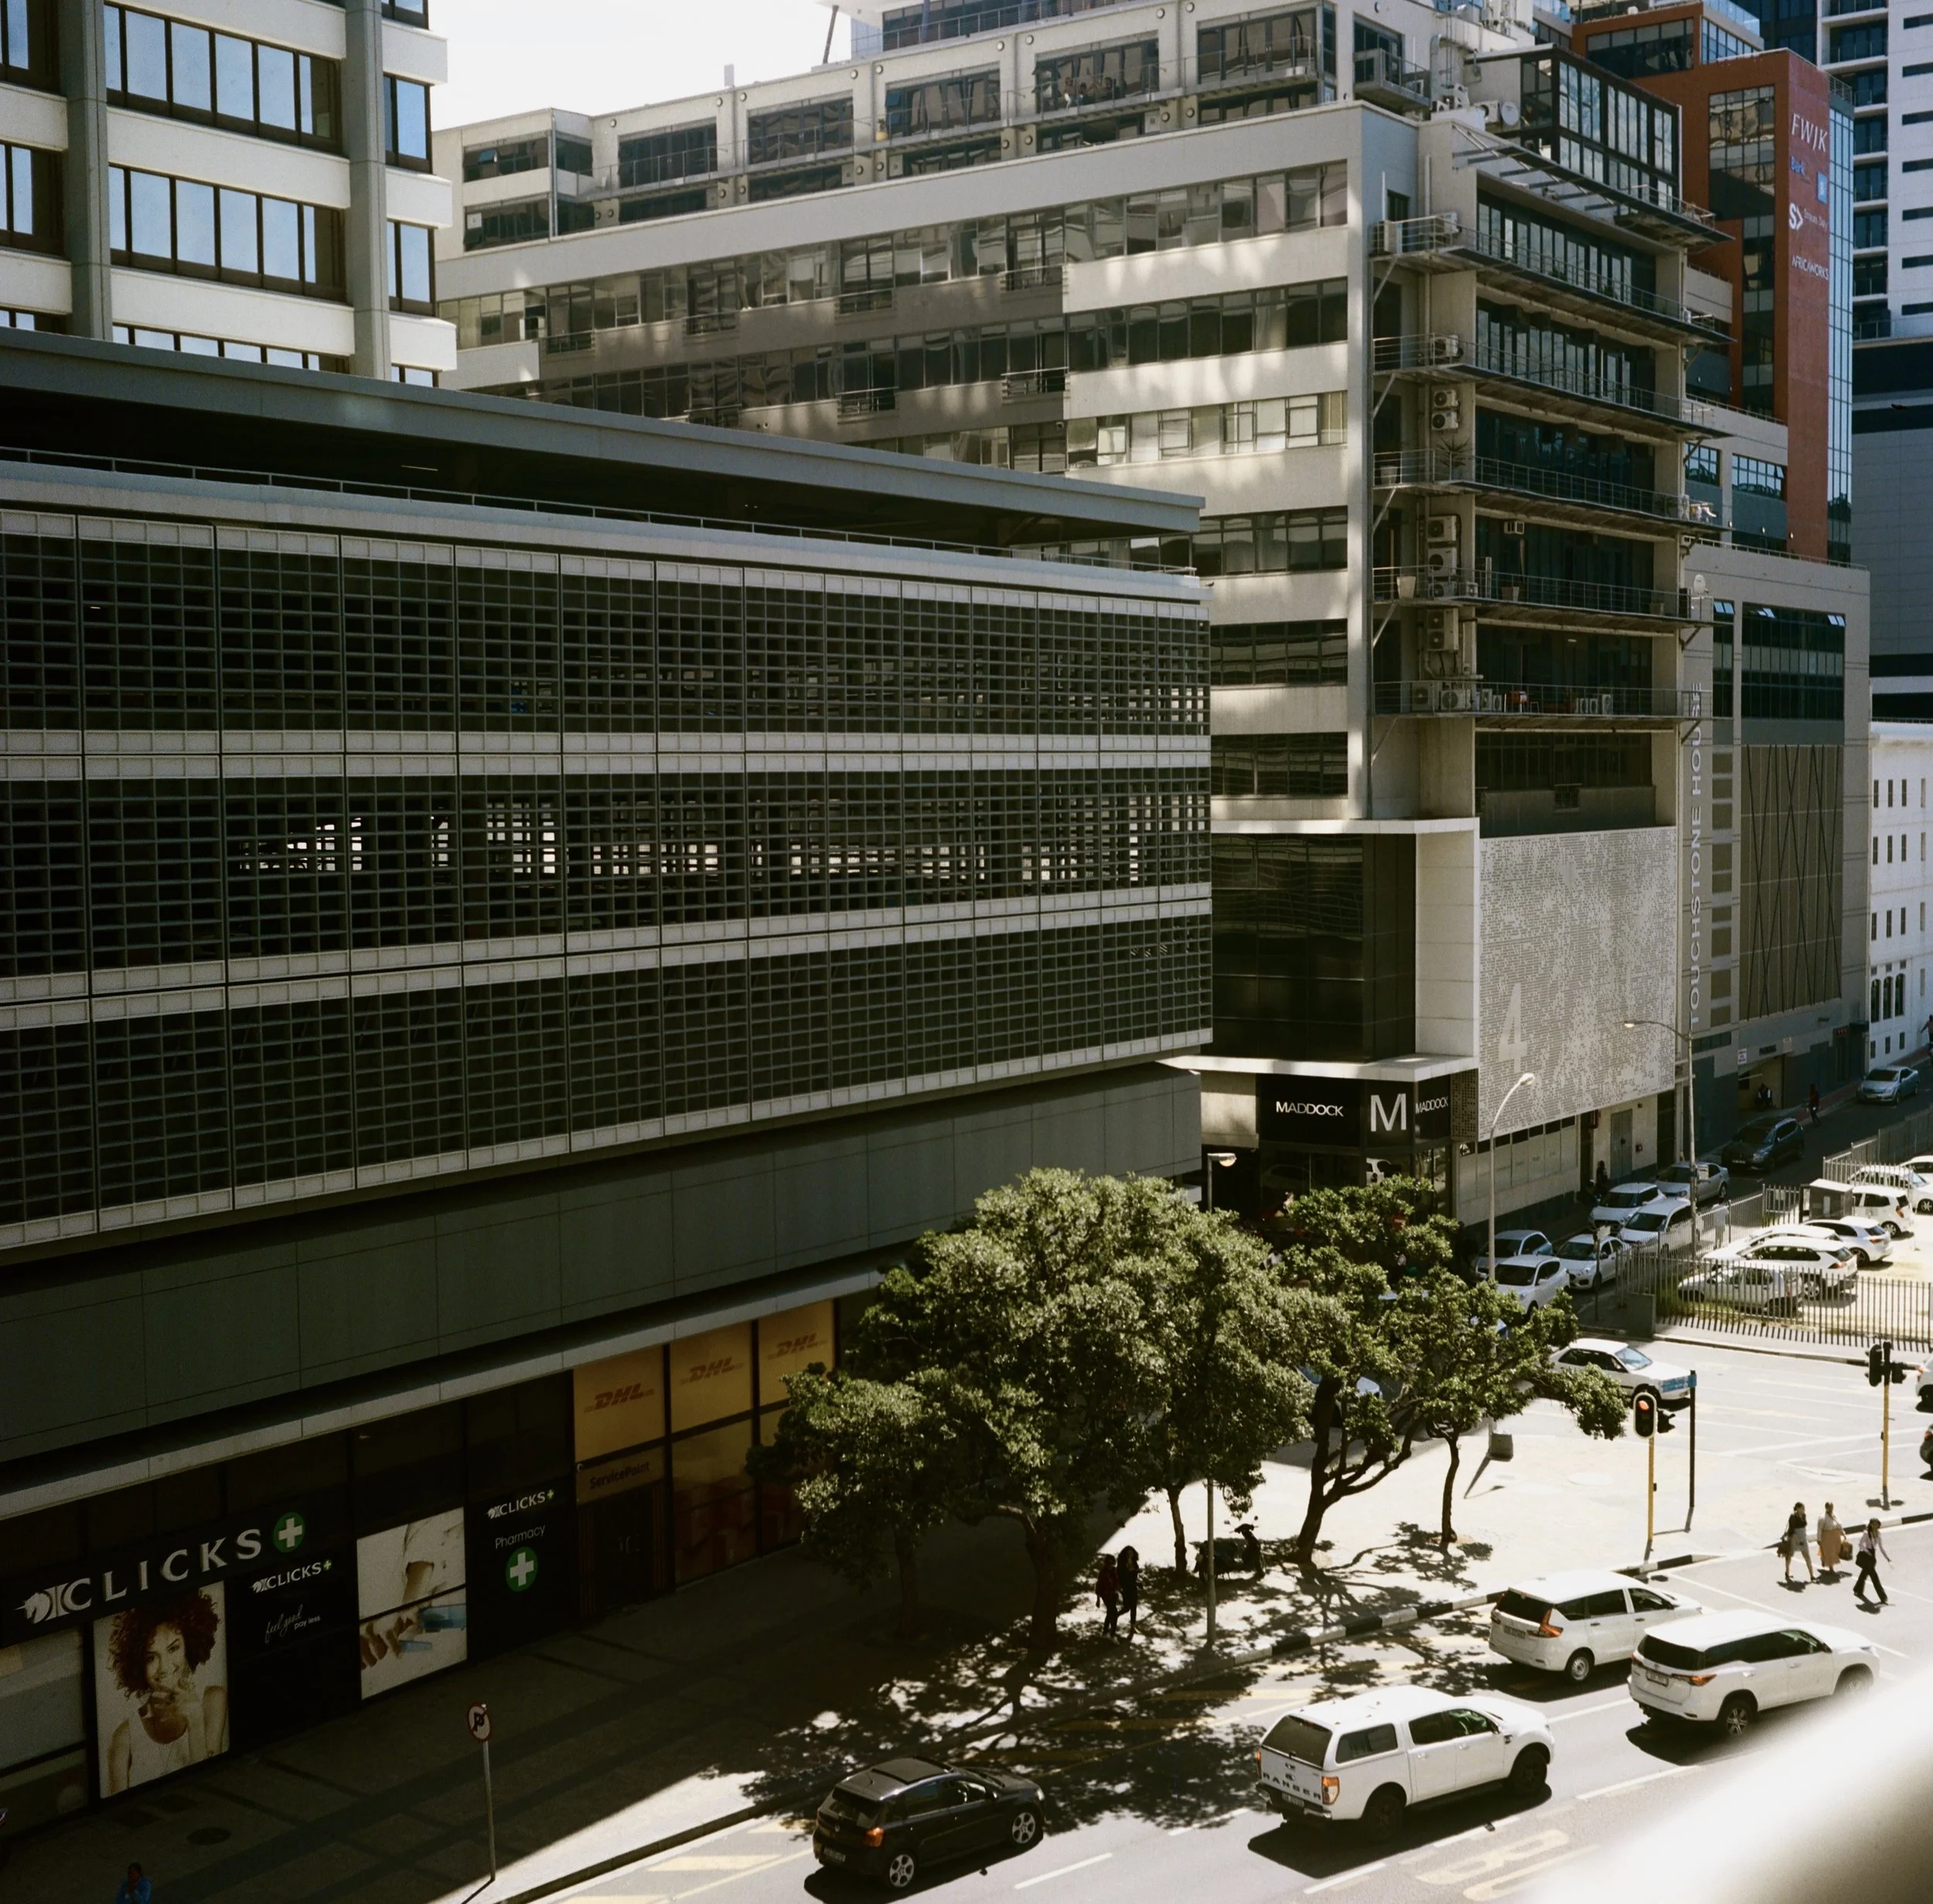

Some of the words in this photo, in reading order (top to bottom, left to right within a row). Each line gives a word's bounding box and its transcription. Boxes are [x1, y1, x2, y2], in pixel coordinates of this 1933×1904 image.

[1692, 682, 1701, 795] HOUSE
[1690, 806, 1701, 1032] TOUCHSTONE
[1498, 983, 1528, 1073] 4
[1276, 1101, 1344, 1117] MADDOCK
[1370, 1093, 1407, 1133] M
[1415, 1096, 1449, 1114] MADDOCK
[776, 1333, 816, 1357] DHL
[690, 1357, 735, 1382] DHL
[594, 1382, 645, 1410] DHL
[589, 1461, 649, 1490] ServicePoint
[499, 1490, 546, 1516] CLICKS
[495, 1524, 547, 1550] Pharmacy
[62, 1528, 263, 1611] CLICKS
[266, 1562, 322, 1589] CLICKS
